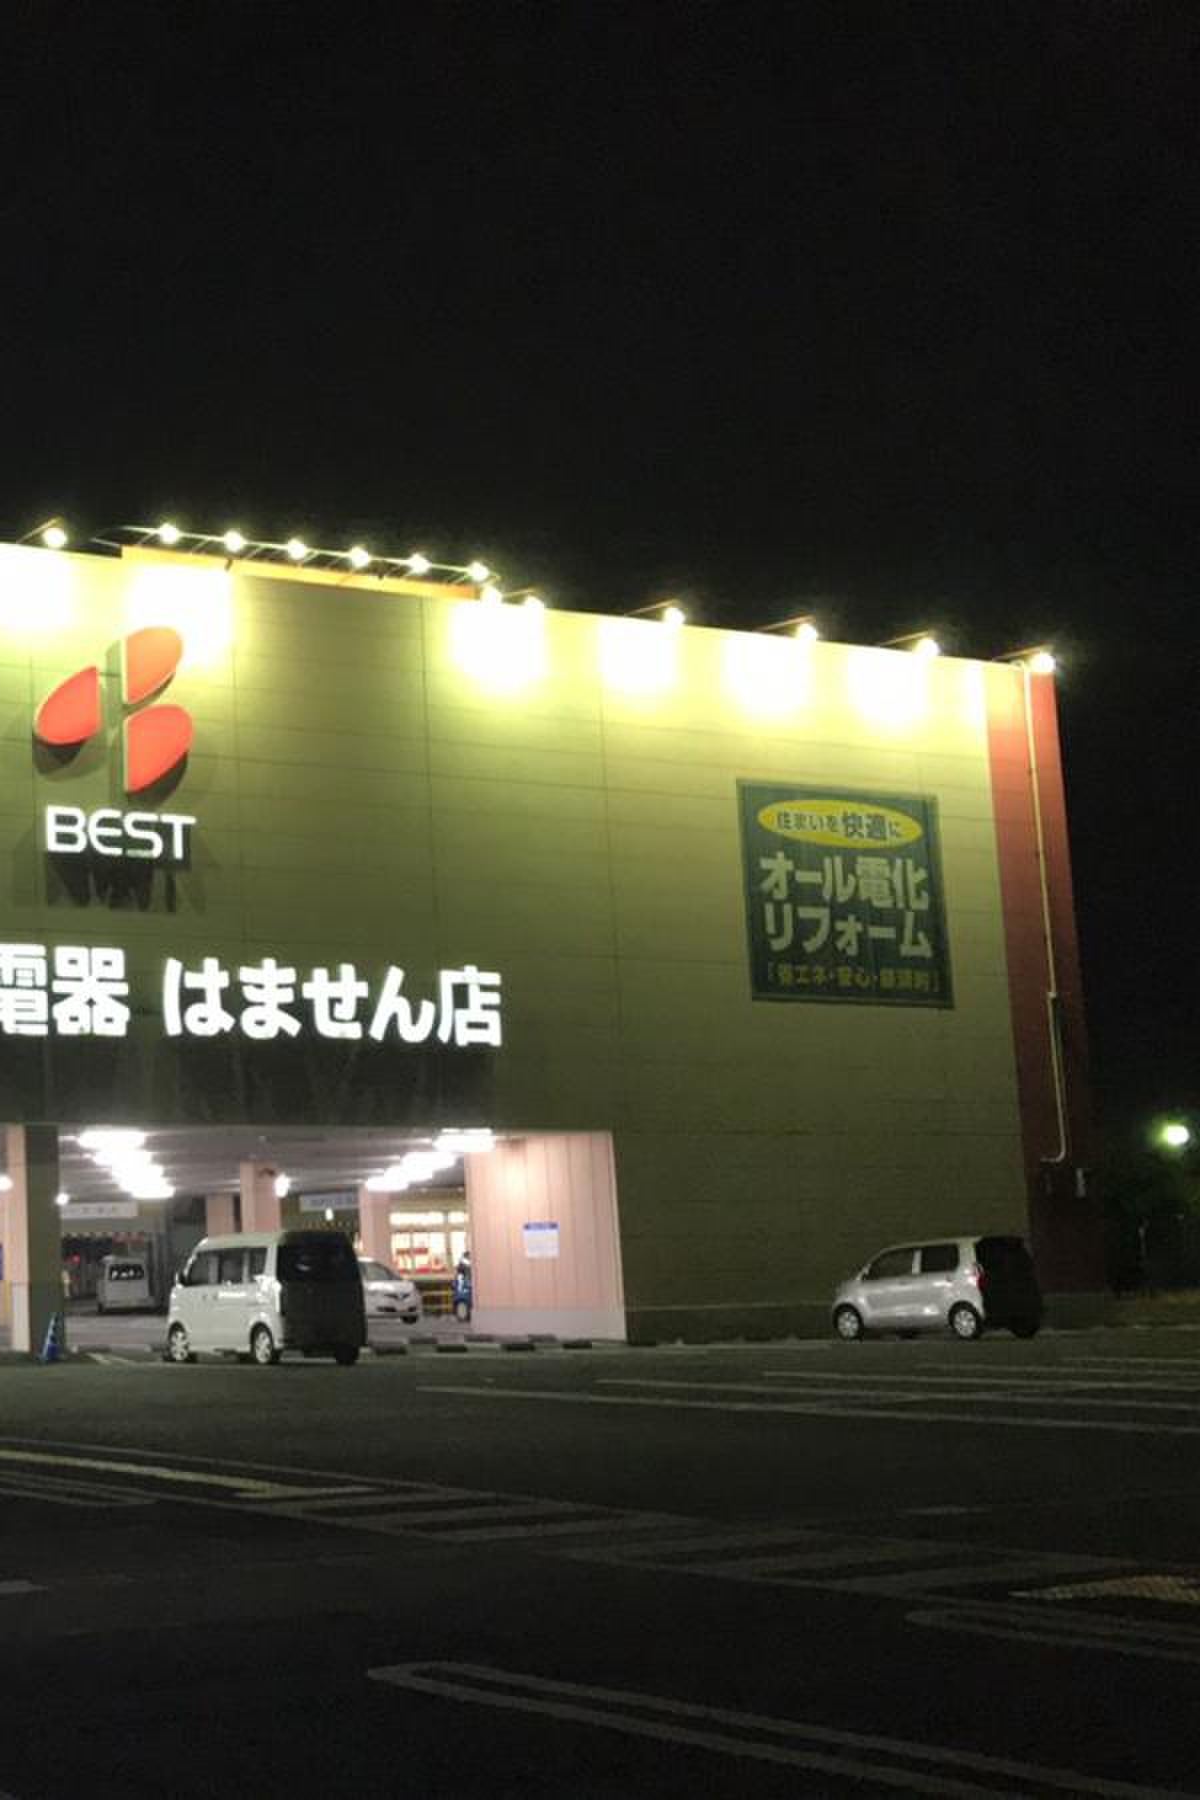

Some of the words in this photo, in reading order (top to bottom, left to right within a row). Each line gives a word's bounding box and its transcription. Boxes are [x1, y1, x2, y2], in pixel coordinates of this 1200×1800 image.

[45, 805, 196, 859] BEST
[759, 852, 929, 911] オール電化
[764, 903, 933, 958] リフォーム
[162, 957, 502, 1047] はません店
